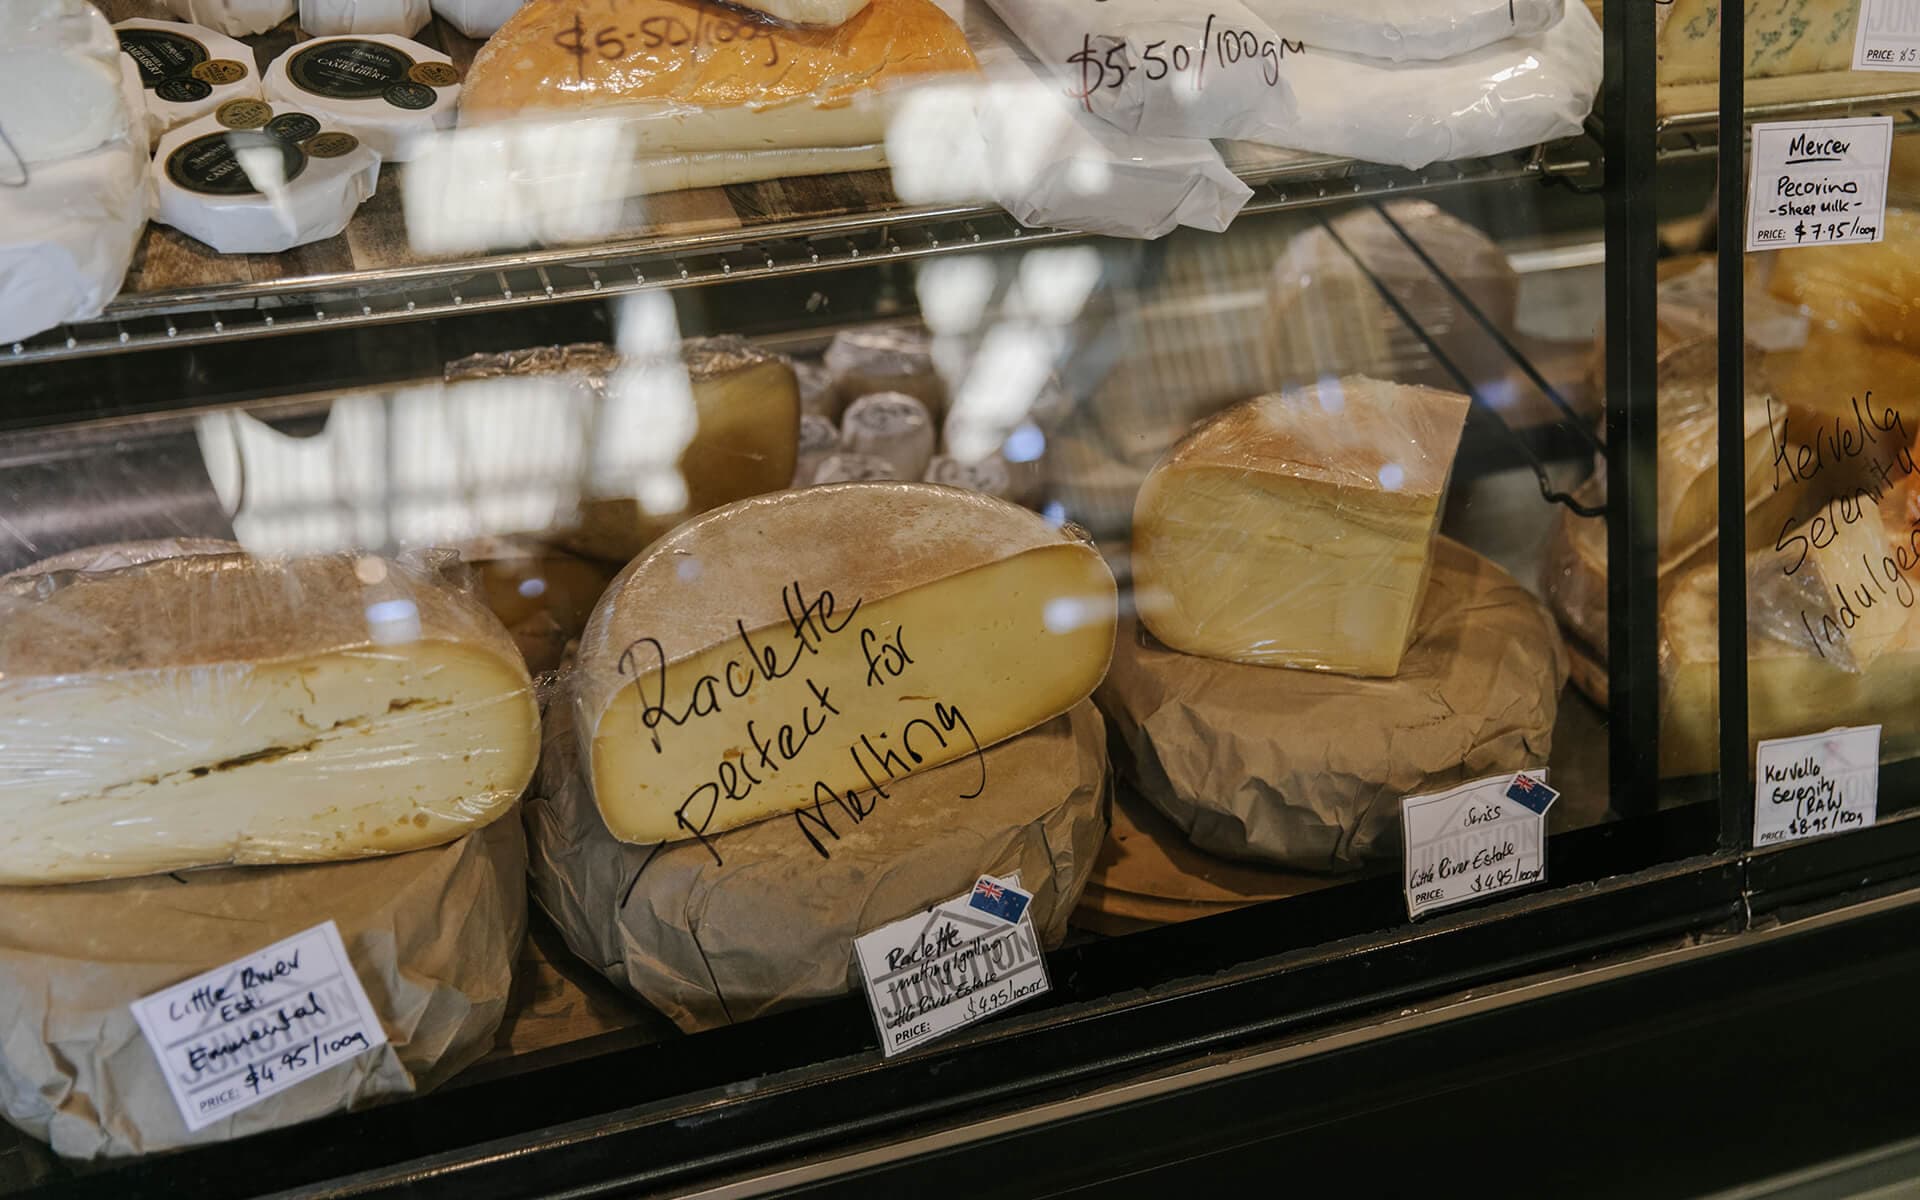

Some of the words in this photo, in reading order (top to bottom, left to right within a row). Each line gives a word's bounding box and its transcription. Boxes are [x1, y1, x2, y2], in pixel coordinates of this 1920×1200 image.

[1866, 49, 1895, 61] PRICE:
[317, 57, 390, 81] CAMEMBERT
[1788, 133, 1851, 157] Mercer
[1777, 175, 1858, 197] Pecorino
[1757, 228, 1786, 241] PRICE:
[1766, 391, 1907, 492] Kervella
[618, 581, 862, 754] Raclette
[860, 625, 914, 687] for
[1438, 857, 1471, 880] River
[1472, 841, 1515, 870] Estate
[1415, 888, 1445, 905] PRICE:
[885, 921, 963, 972] Raclette
[169, 984, 232, 1022] Little
[240, 948, 299, 990] River
[955, 971, 999, 999] Estate
[894, 1021, 932, 1046] PRICE:
[199, 1088, 240, 1111] PRICE:
